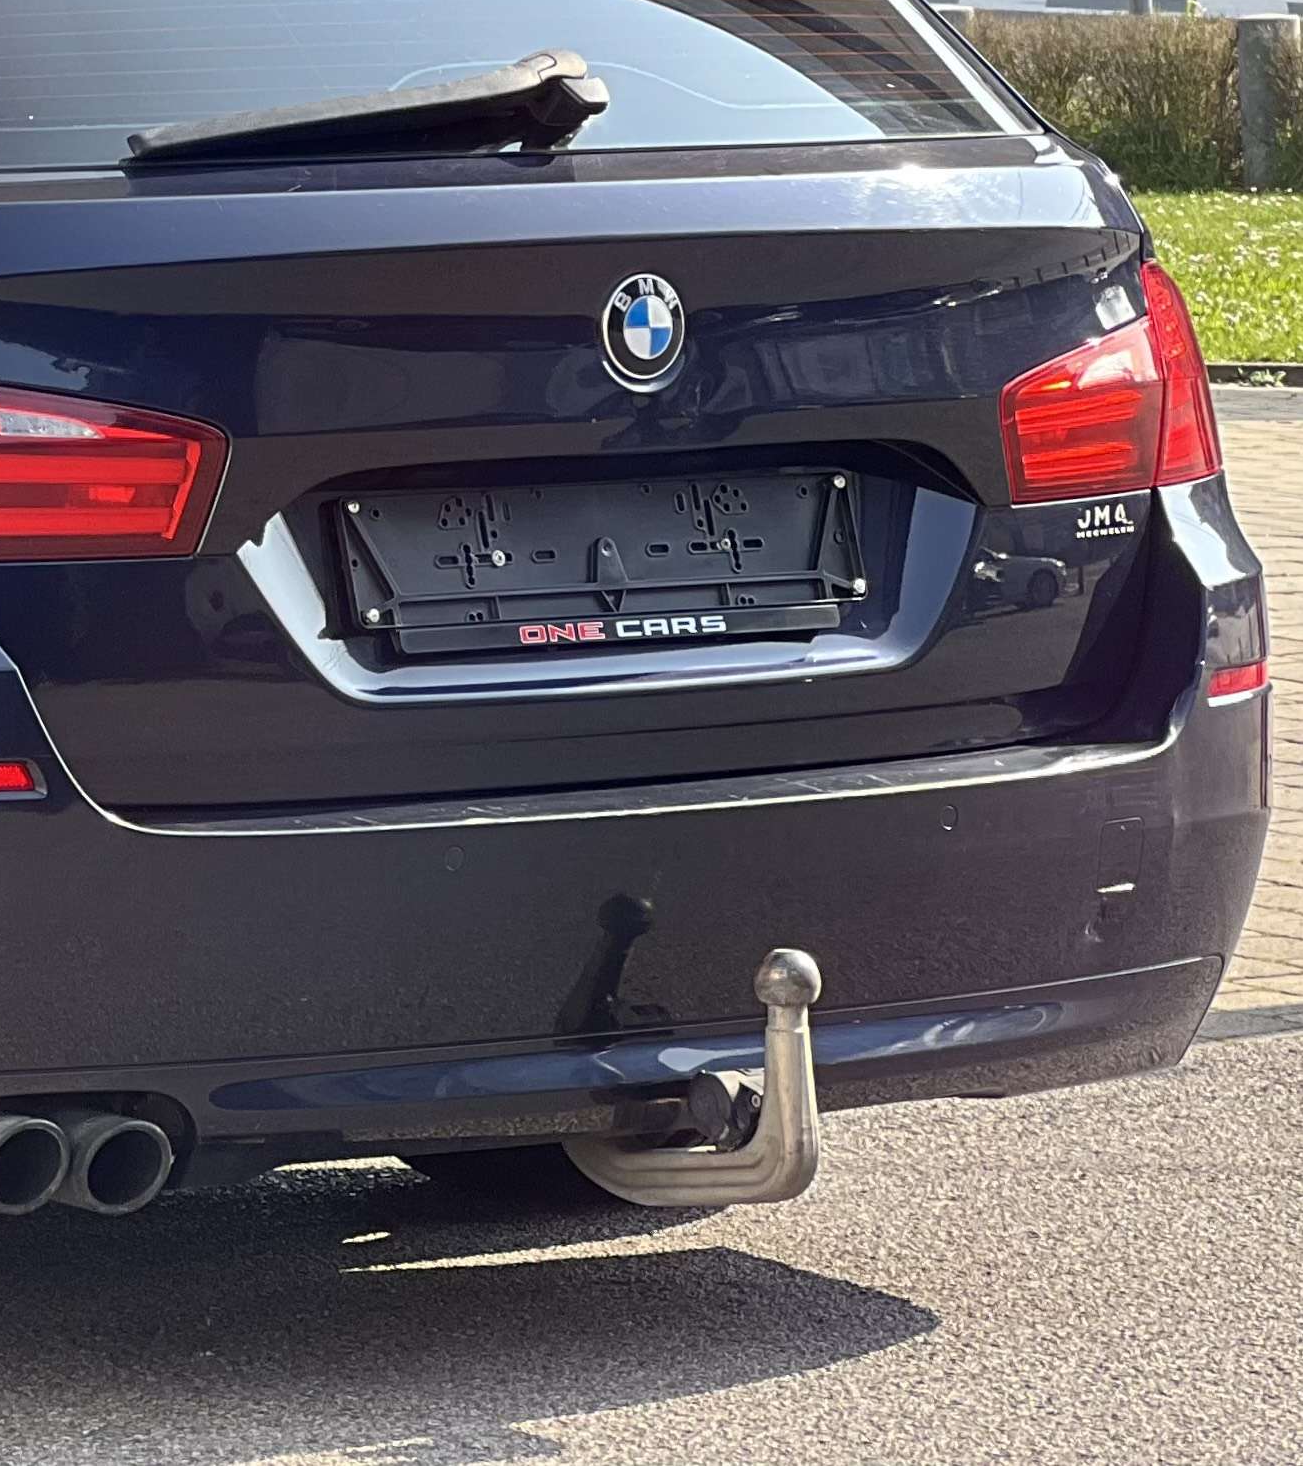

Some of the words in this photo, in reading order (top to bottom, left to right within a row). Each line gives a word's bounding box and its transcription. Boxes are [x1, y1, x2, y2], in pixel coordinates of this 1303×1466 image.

[613, 277, 679, 313] BMW
[1077, 503, 1134, 529] JMA
[519, 621, 606, 644] ONE
[615, 615, 727, 638] CARS
